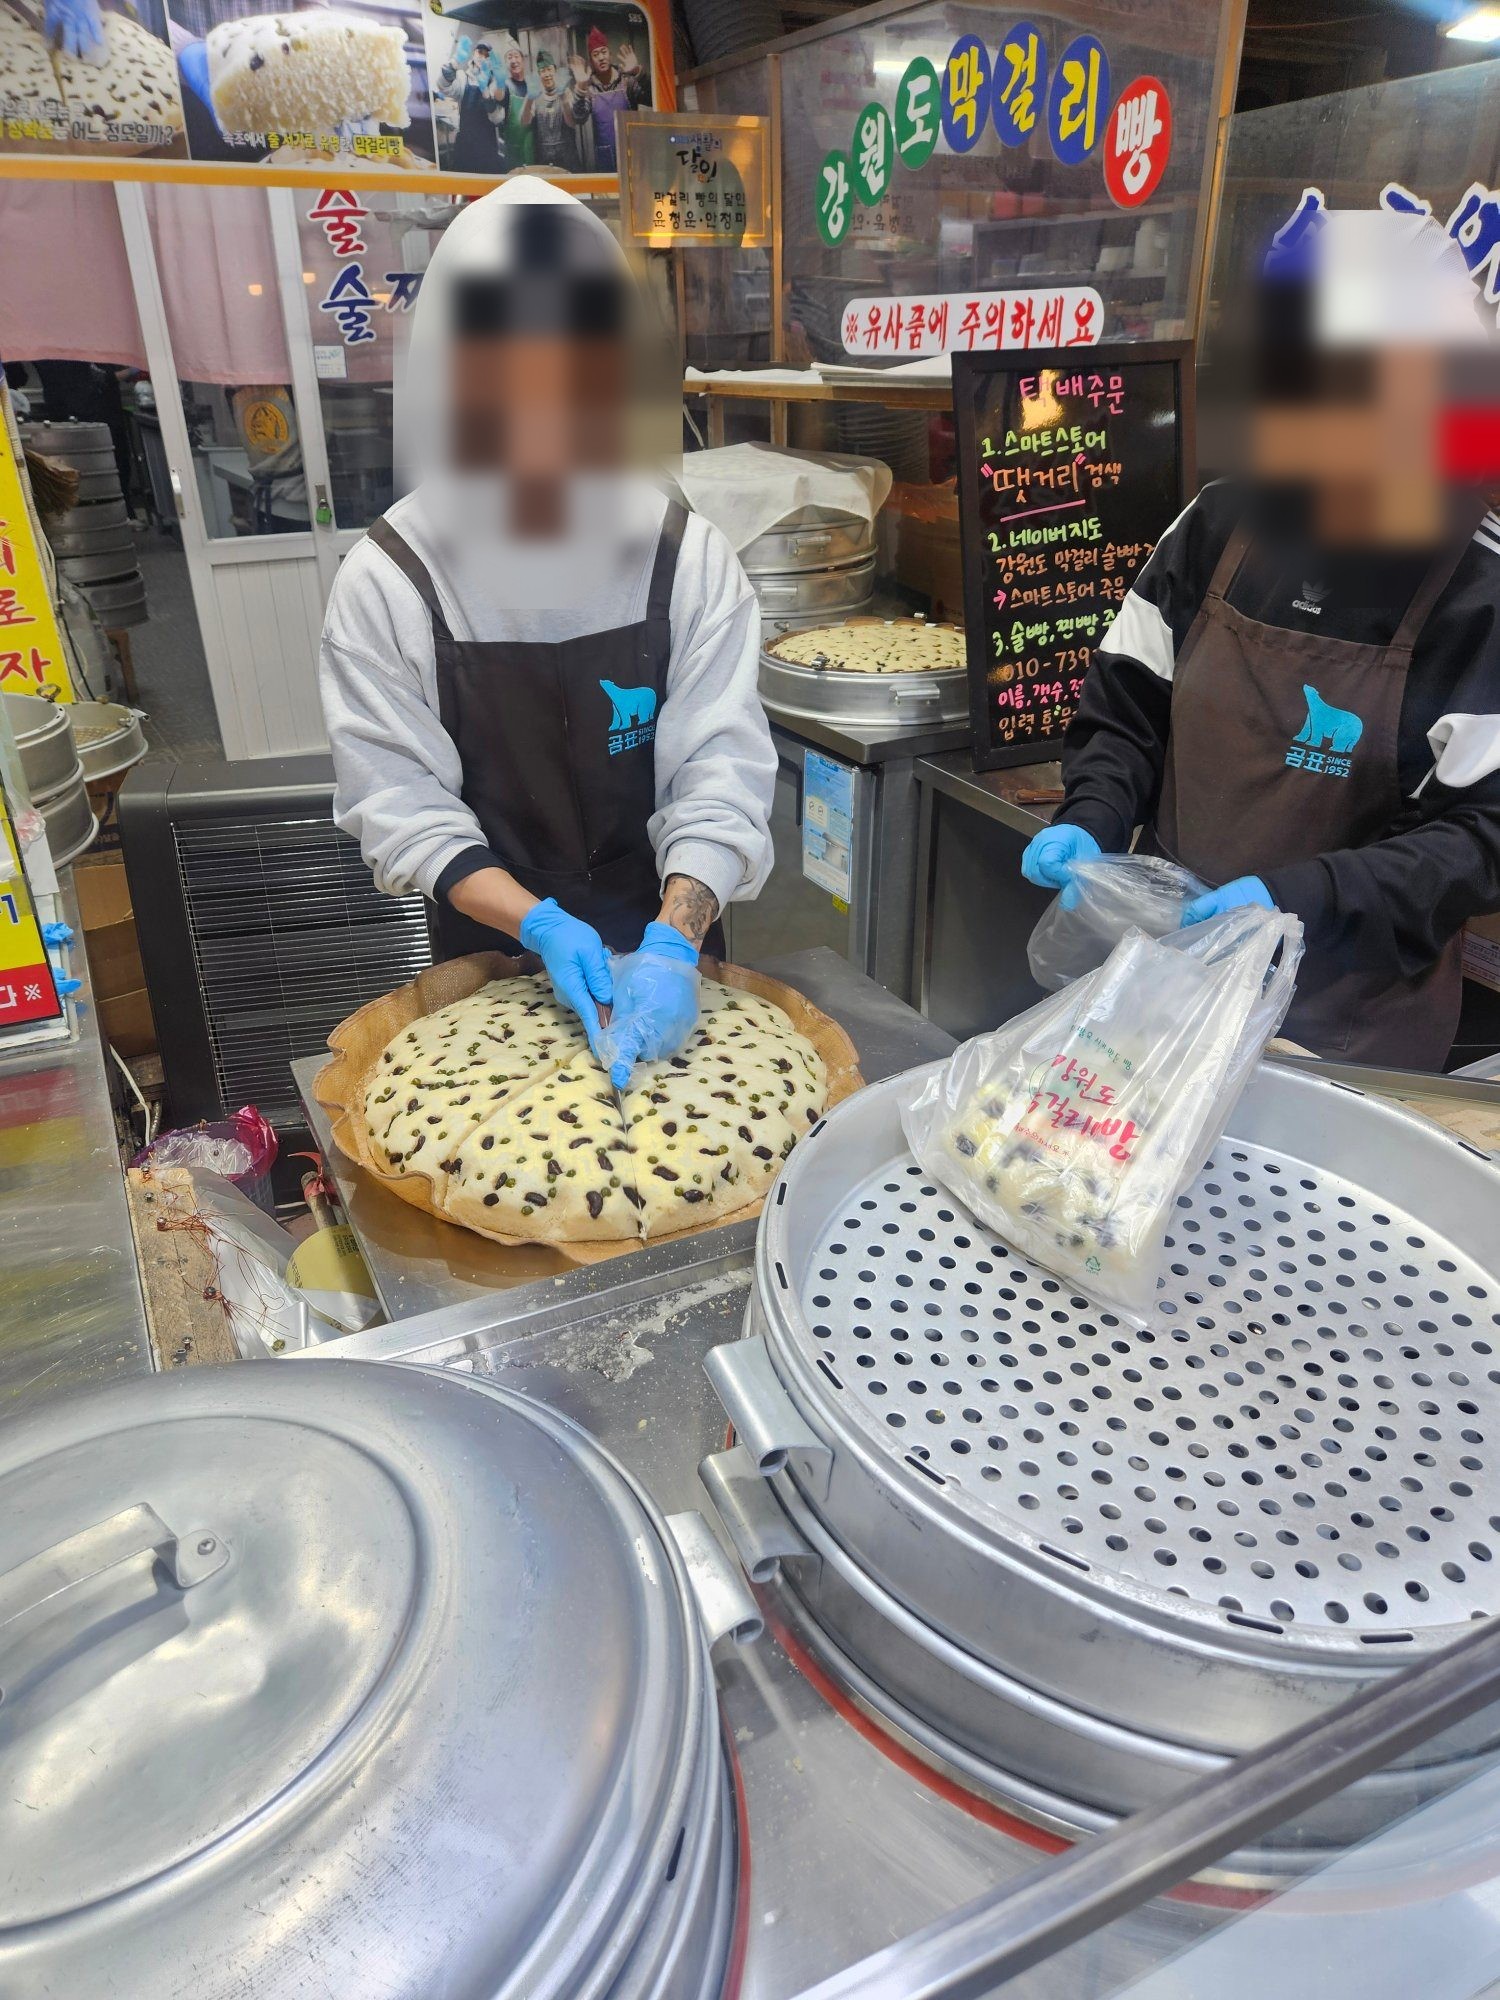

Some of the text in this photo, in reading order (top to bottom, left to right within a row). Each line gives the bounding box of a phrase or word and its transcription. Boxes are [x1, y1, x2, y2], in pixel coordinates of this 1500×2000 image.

[72, 121, 100, 141] 어느
[309, 189, 370, 255] 술
[321, 264, 377, 342] 술
[958, 295, 1095, 352] 주의하세요
[1084, 462, 1122, 488] 검색
[996, 553, 1048, 584] 강원도
[1010, 581, 1095, 608] 스마트스토어
[1292, 599, 1322, 615] adidas
[1056, 613, 1099, 639] 찐빵
[998, 713, 1035, 740] 입력
[608, 730, 639, 755] 곰표
[1285, 746, 1326, 773] 곰표
[1324, 765, 1350, 778] 1952
[1326, 756, 1353, 768] SINCE
[1051, 1054, 1119, 1107] 강원도
